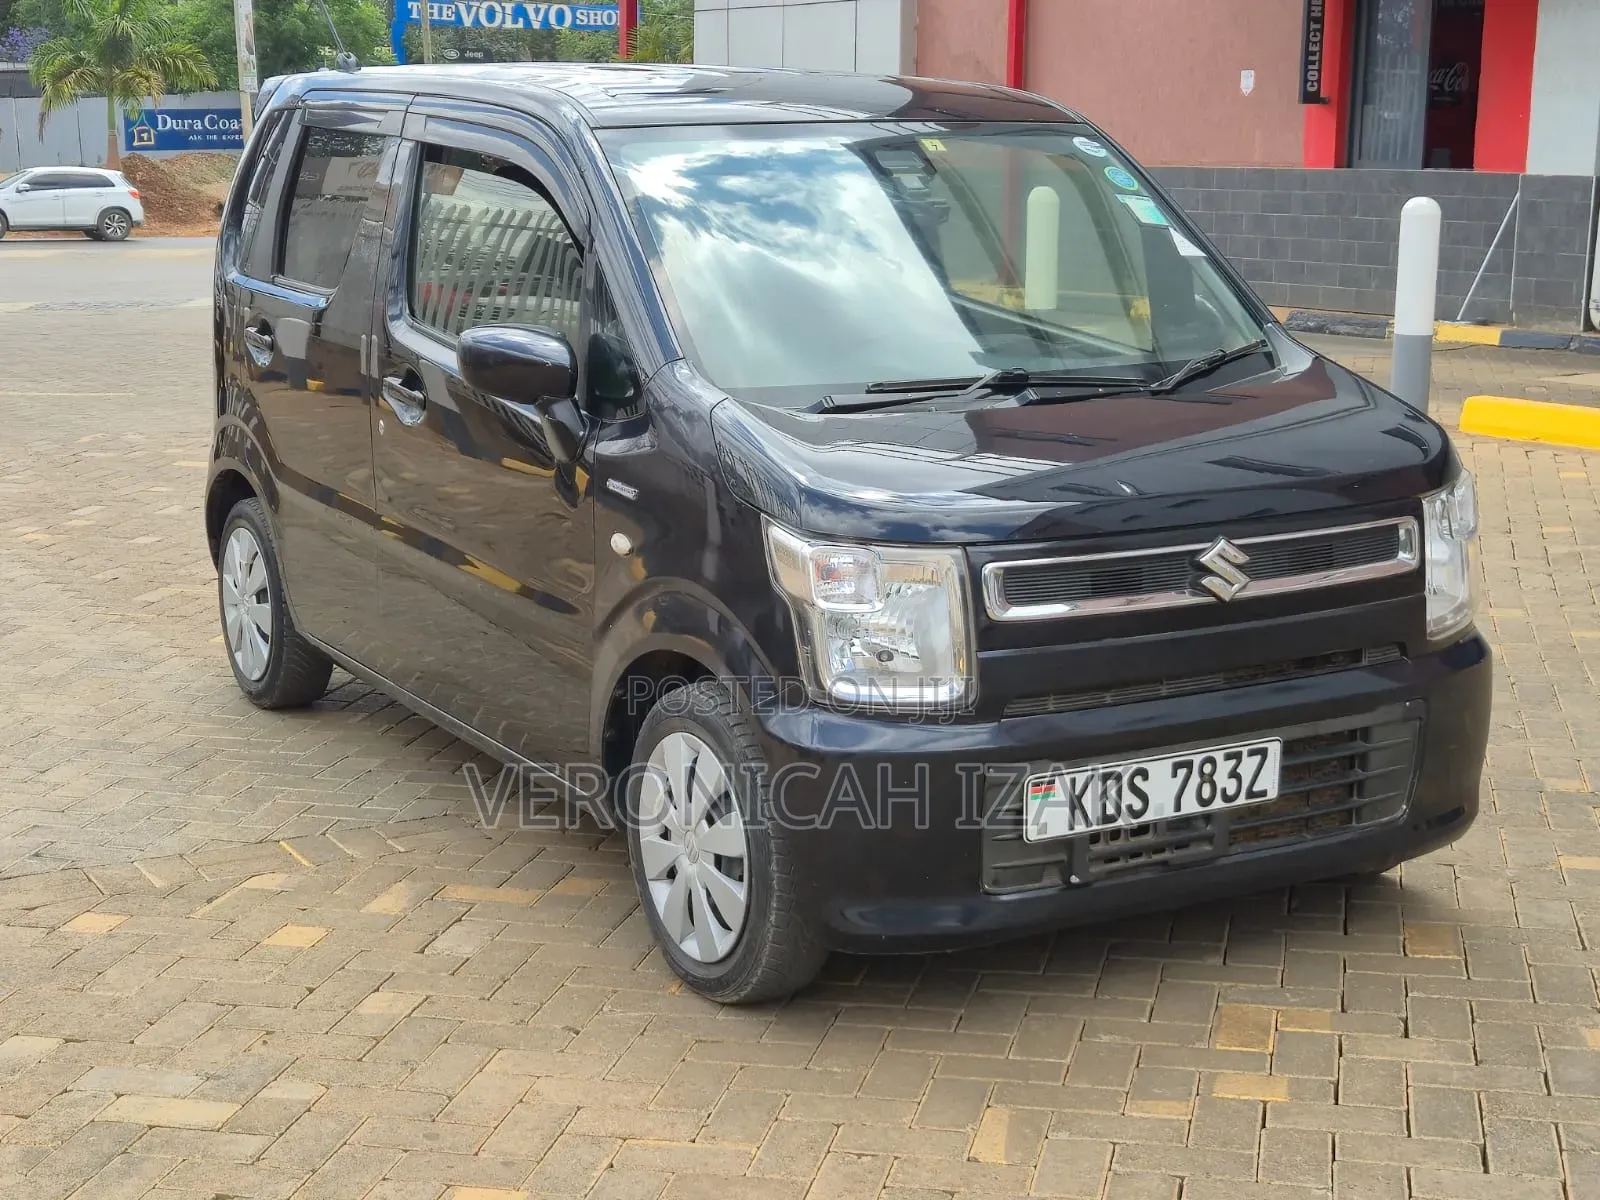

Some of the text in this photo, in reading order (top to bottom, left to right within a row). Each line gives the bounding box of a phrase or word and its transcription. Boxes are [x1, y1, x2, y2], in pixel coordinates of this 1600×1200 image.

[407, 0, 620, 29] THE VOLVO SHO
[464, 50, 484, 59] Jeep
[1306, 20, 1321, 92] COLLECT
